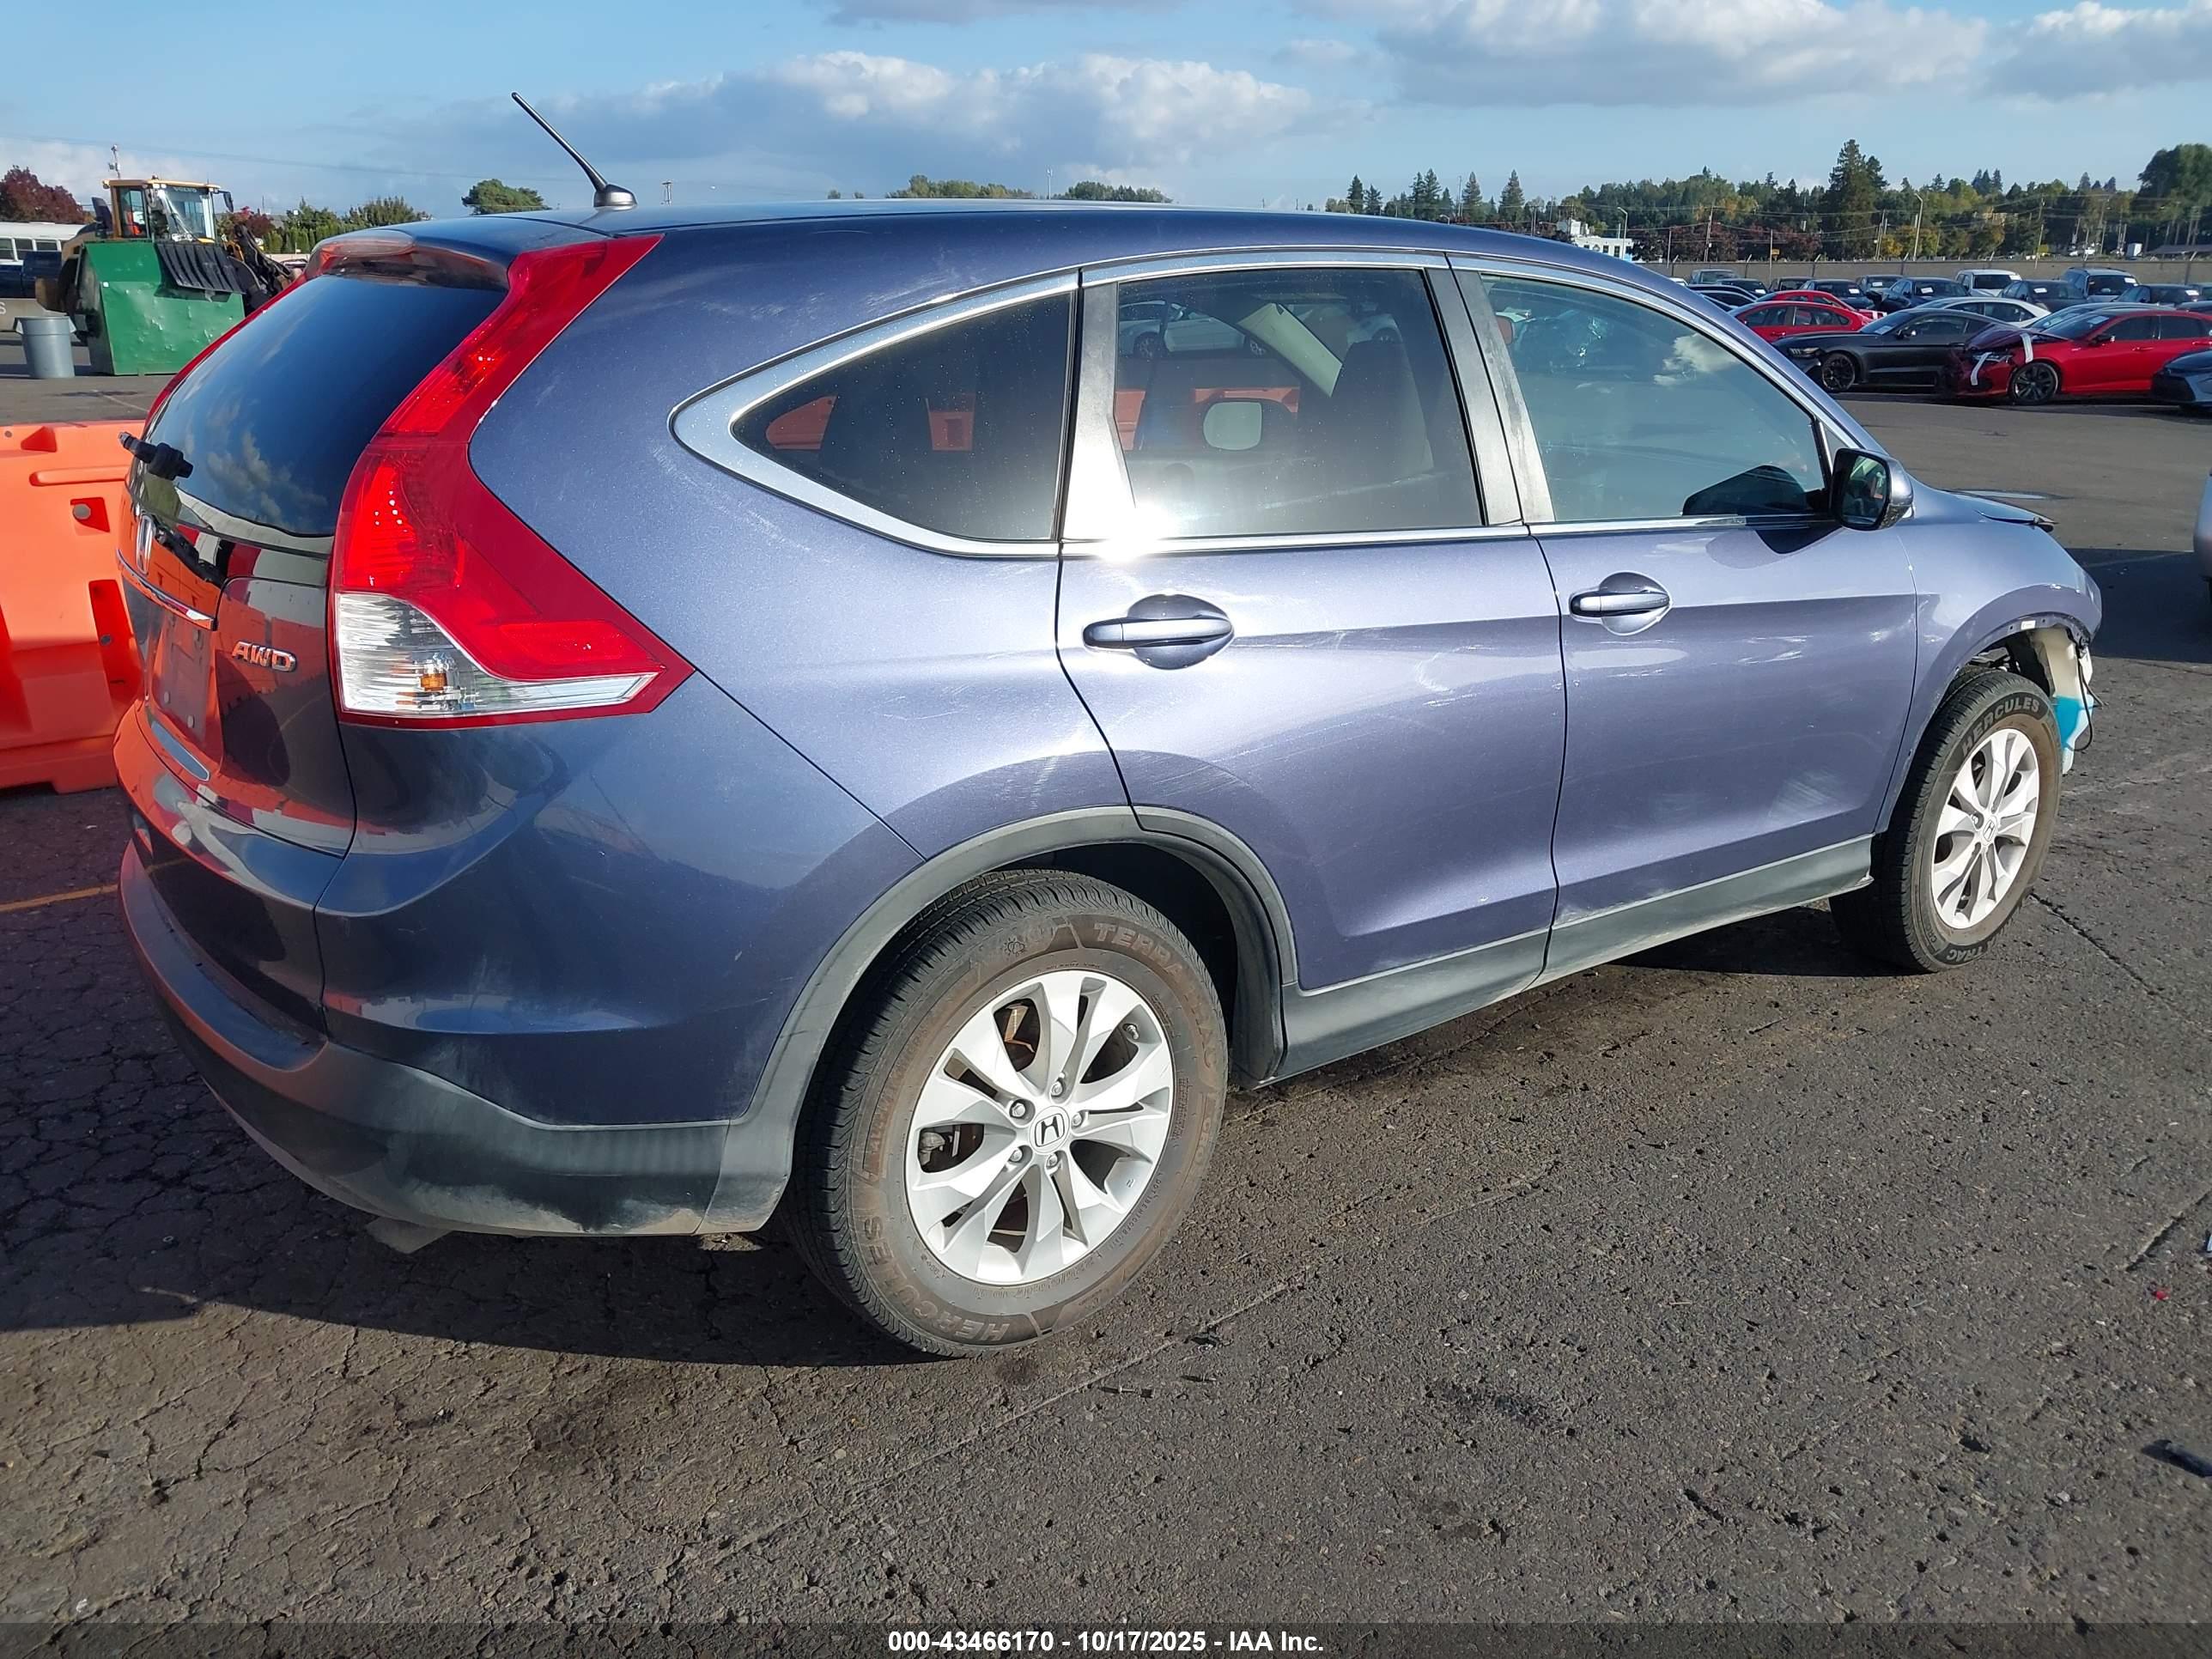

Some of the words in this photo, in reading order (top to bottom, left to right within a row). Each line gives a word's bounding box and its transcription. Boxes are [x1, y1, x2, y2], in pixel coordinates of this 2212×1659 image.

[232, 641, 296, 672] AWD
[1961, 696, 2040, 757] HERCULES
[1094, 922, 1182, 975] TERRA
[1946, 946, 1983, 963] TRAC
